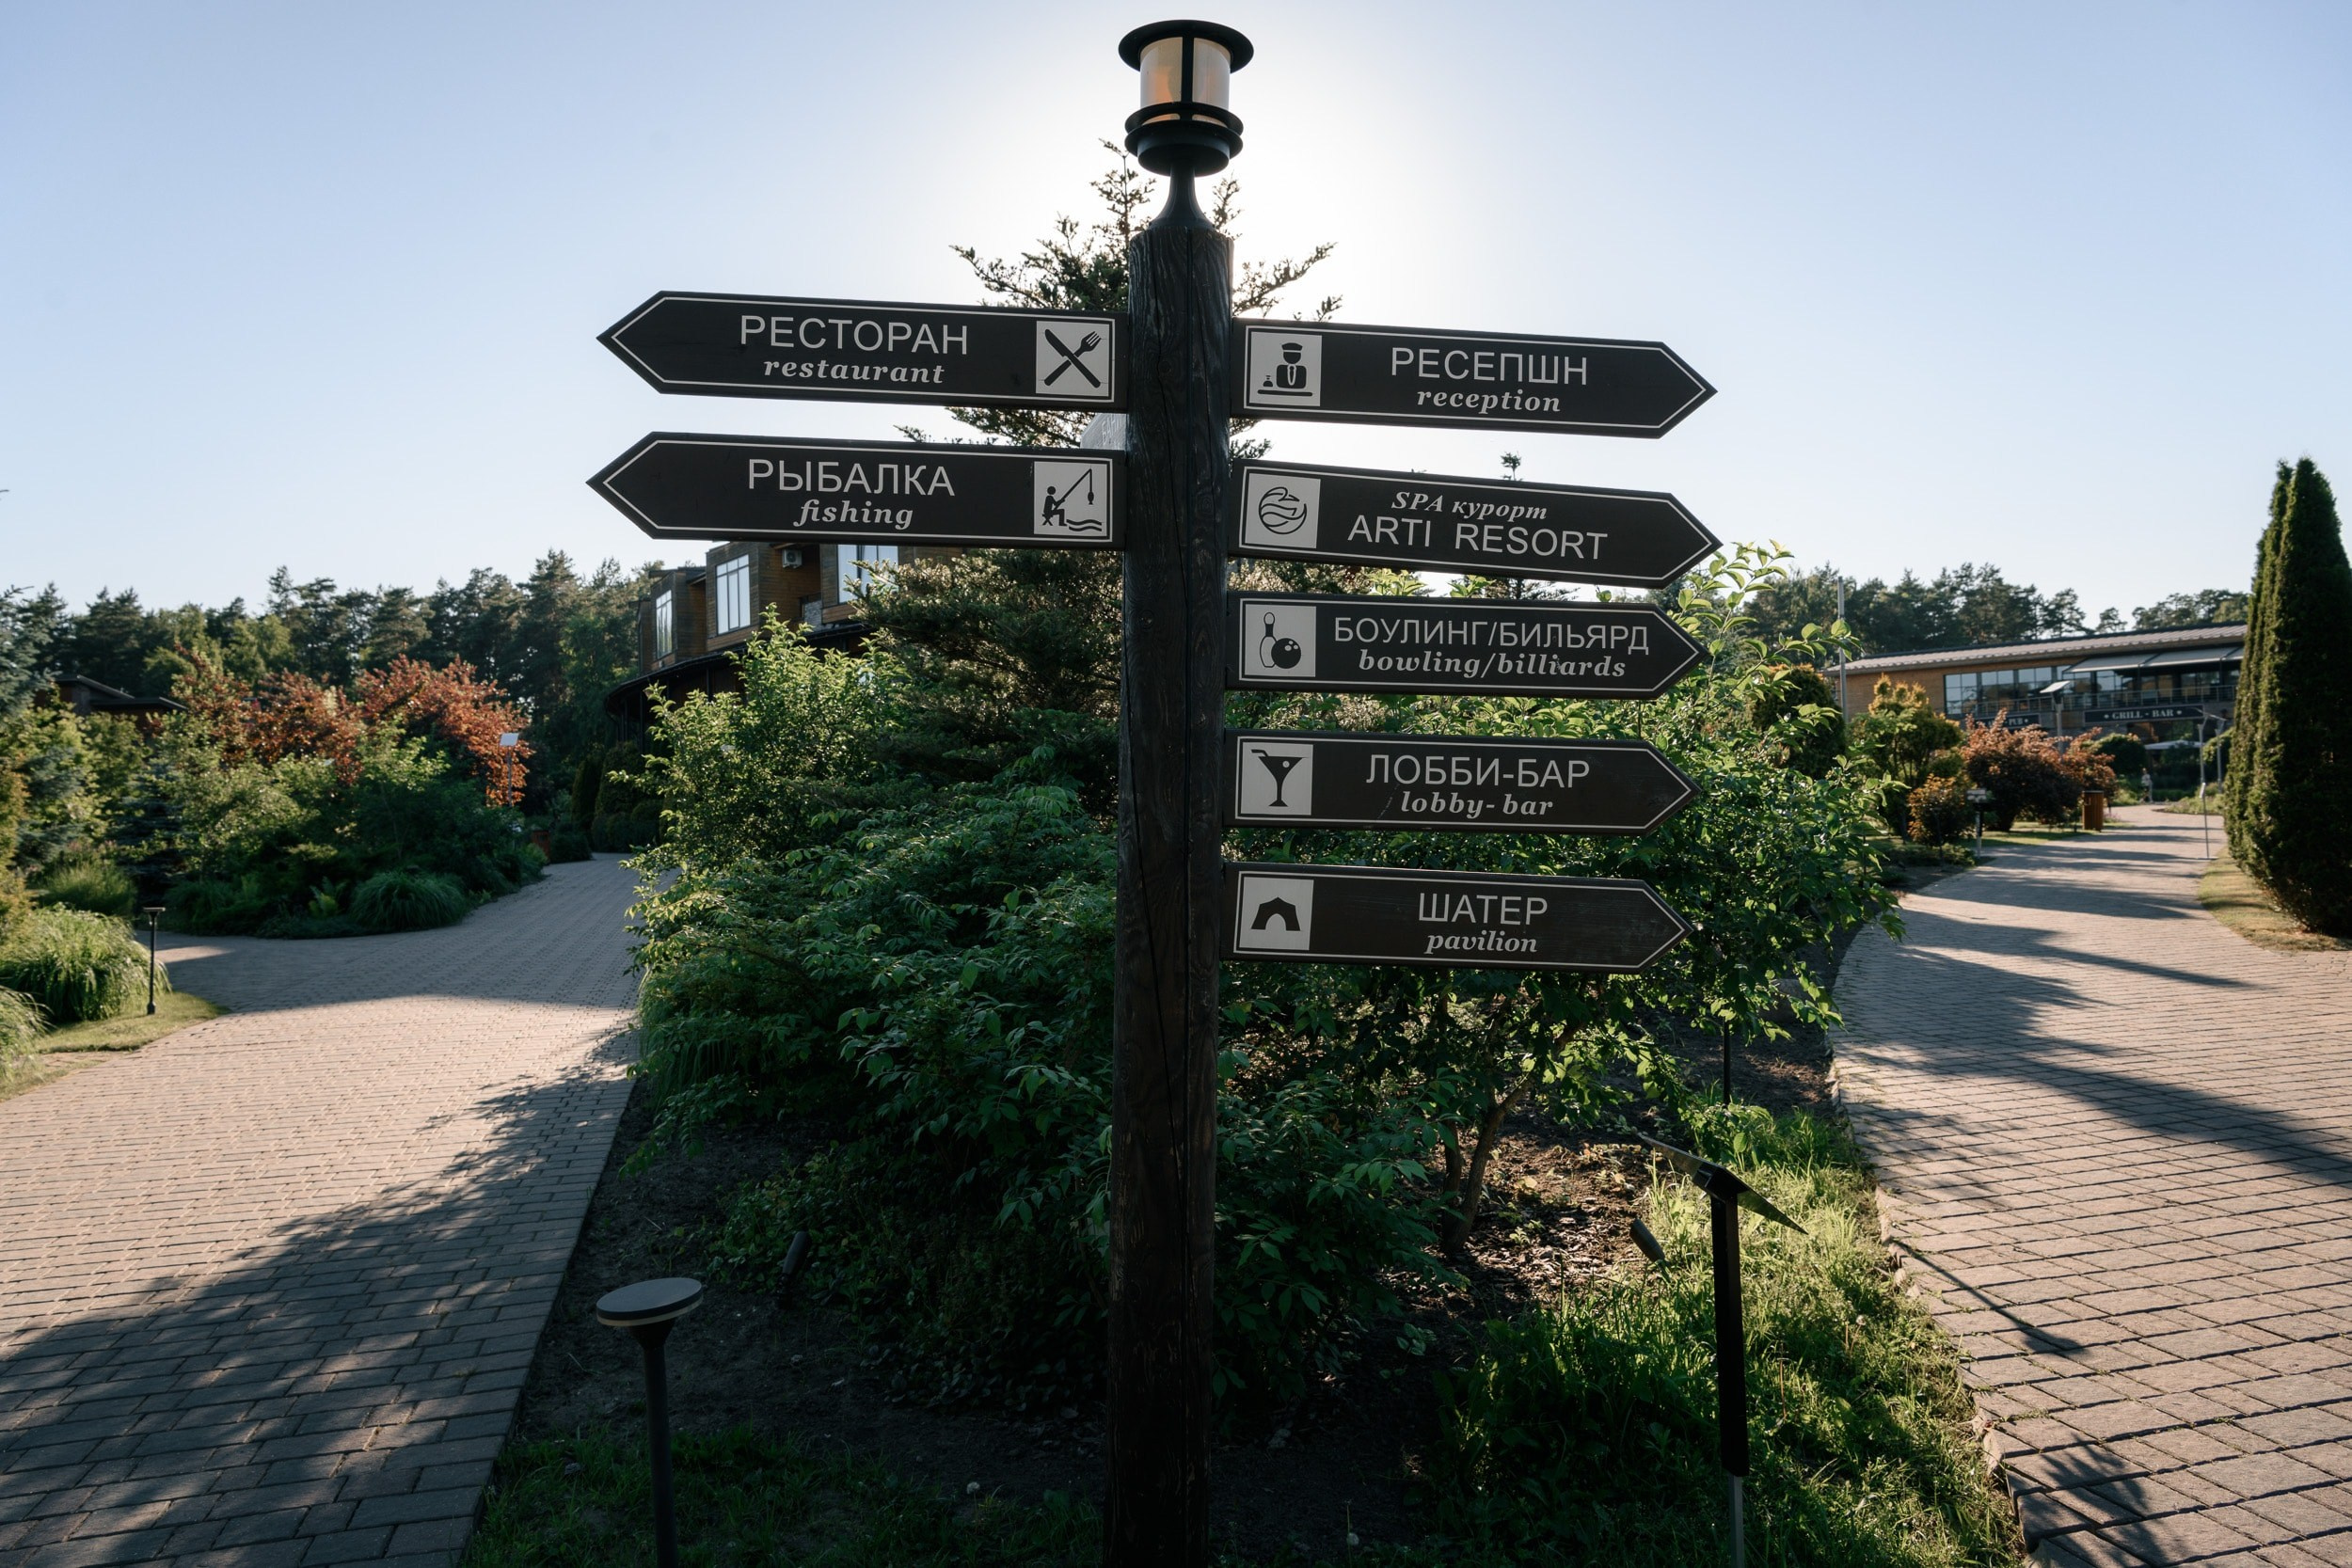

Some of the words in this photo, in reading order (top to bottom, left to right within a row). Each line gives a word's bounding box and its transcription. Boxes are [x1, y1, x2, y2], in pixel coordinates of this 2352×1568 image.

[740, 314, 968, 356] РЕСТОРАН
[763, 359, 946, 384] restaurant
[1391, 346, 1587, 386] РЕСЕПШН
[1417, 388, 1561, 415] reception
[748, 458, 956, 497] РЫБАЛКА
[792, 499, 914, 531] fishing
[1391, 491, 1443, 513] SPA
[1452, 500, 1548, 523] курорт
[1347, 515, 1431, 547] ARTI
[1454, 522, 1609, 560] RESORT
[1334, 616, 1649, 656] БОУЛИНГ/БИЛЬЯРД
[1359, 648, 1626, 679] bowling/billiards
[2112, 710, 2143, 720] GRILL
[2152, 708, 2174, 718] BAR
[1365, 753, 1590, 788] ЛОББИ-БАР
[1418, 892, 1548, 926] ШАТЕР
[1423, 929, 1537, 955] pavilion
